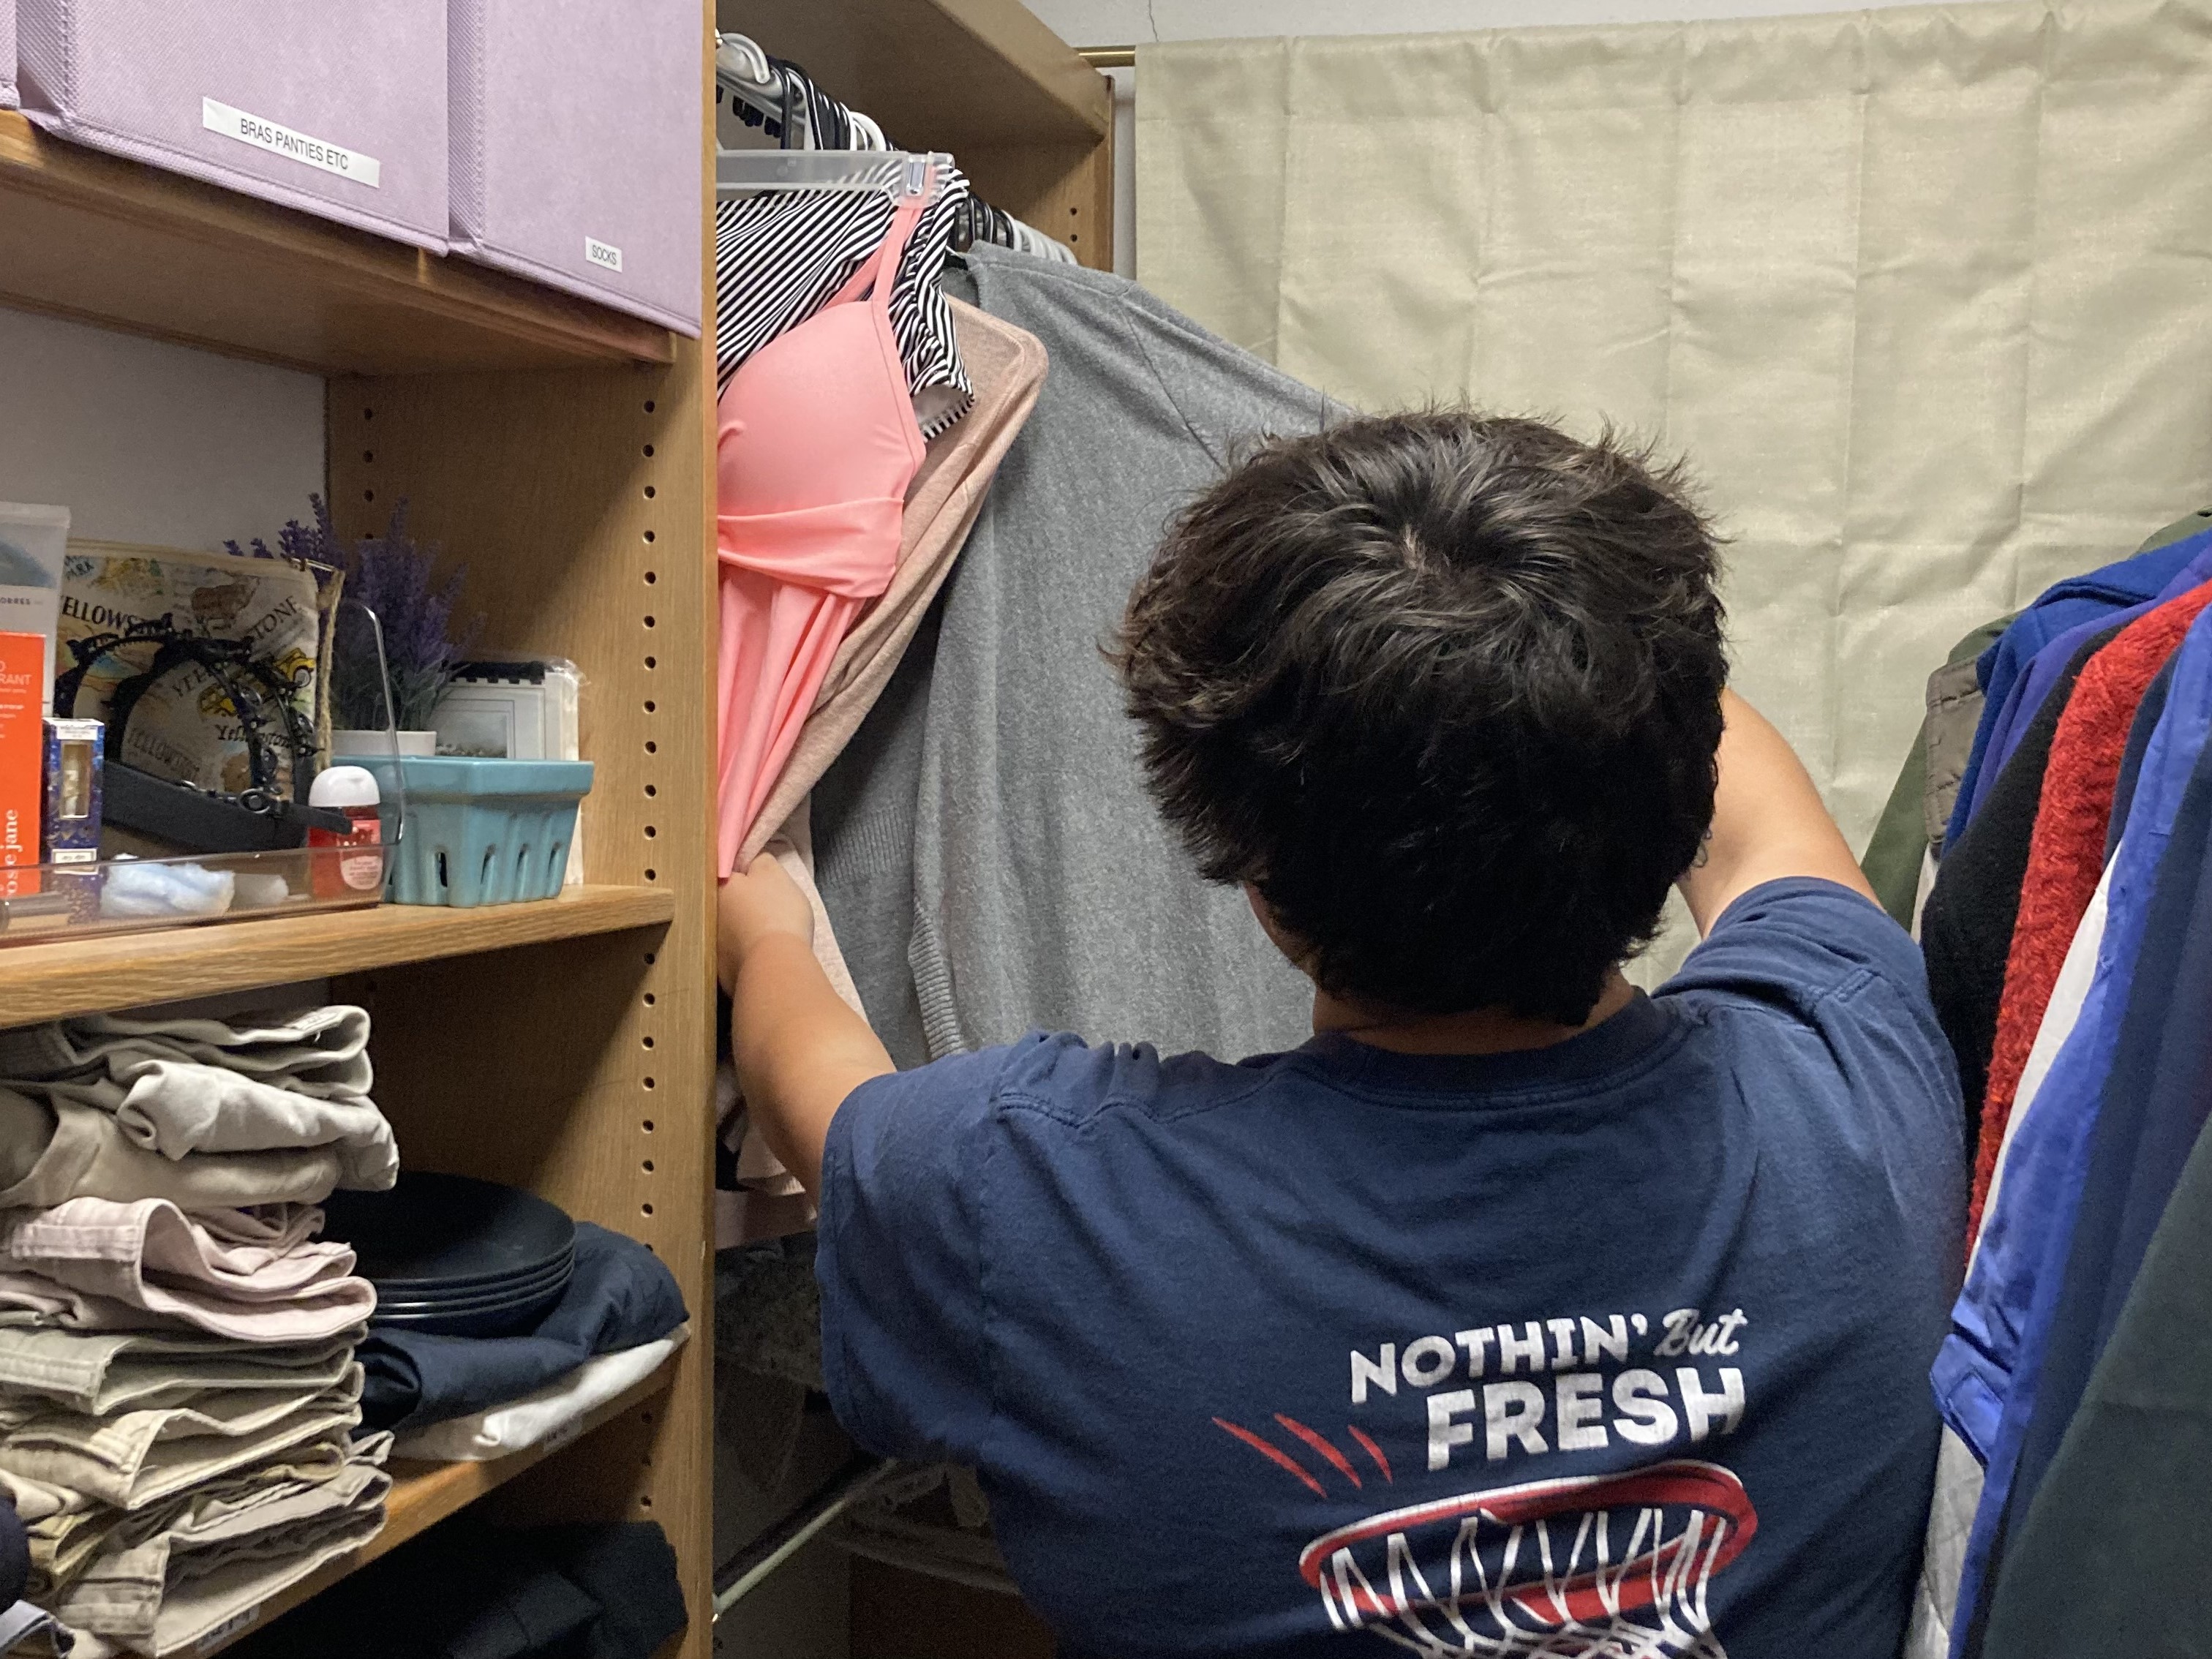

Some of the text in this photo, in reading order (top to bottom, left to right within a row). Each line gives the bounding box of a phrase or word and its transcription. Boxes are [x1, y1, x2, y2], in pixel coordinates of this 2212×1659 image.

[241, 118, 349, 170] BRAS PANTIES ETC
[592, 244, 617, 266] SOCKS
[0, 809, 23, 852] jane
[1652, 1307, 1748, 1356] But
[1426, 1366, 1746, 1471] FRESH
